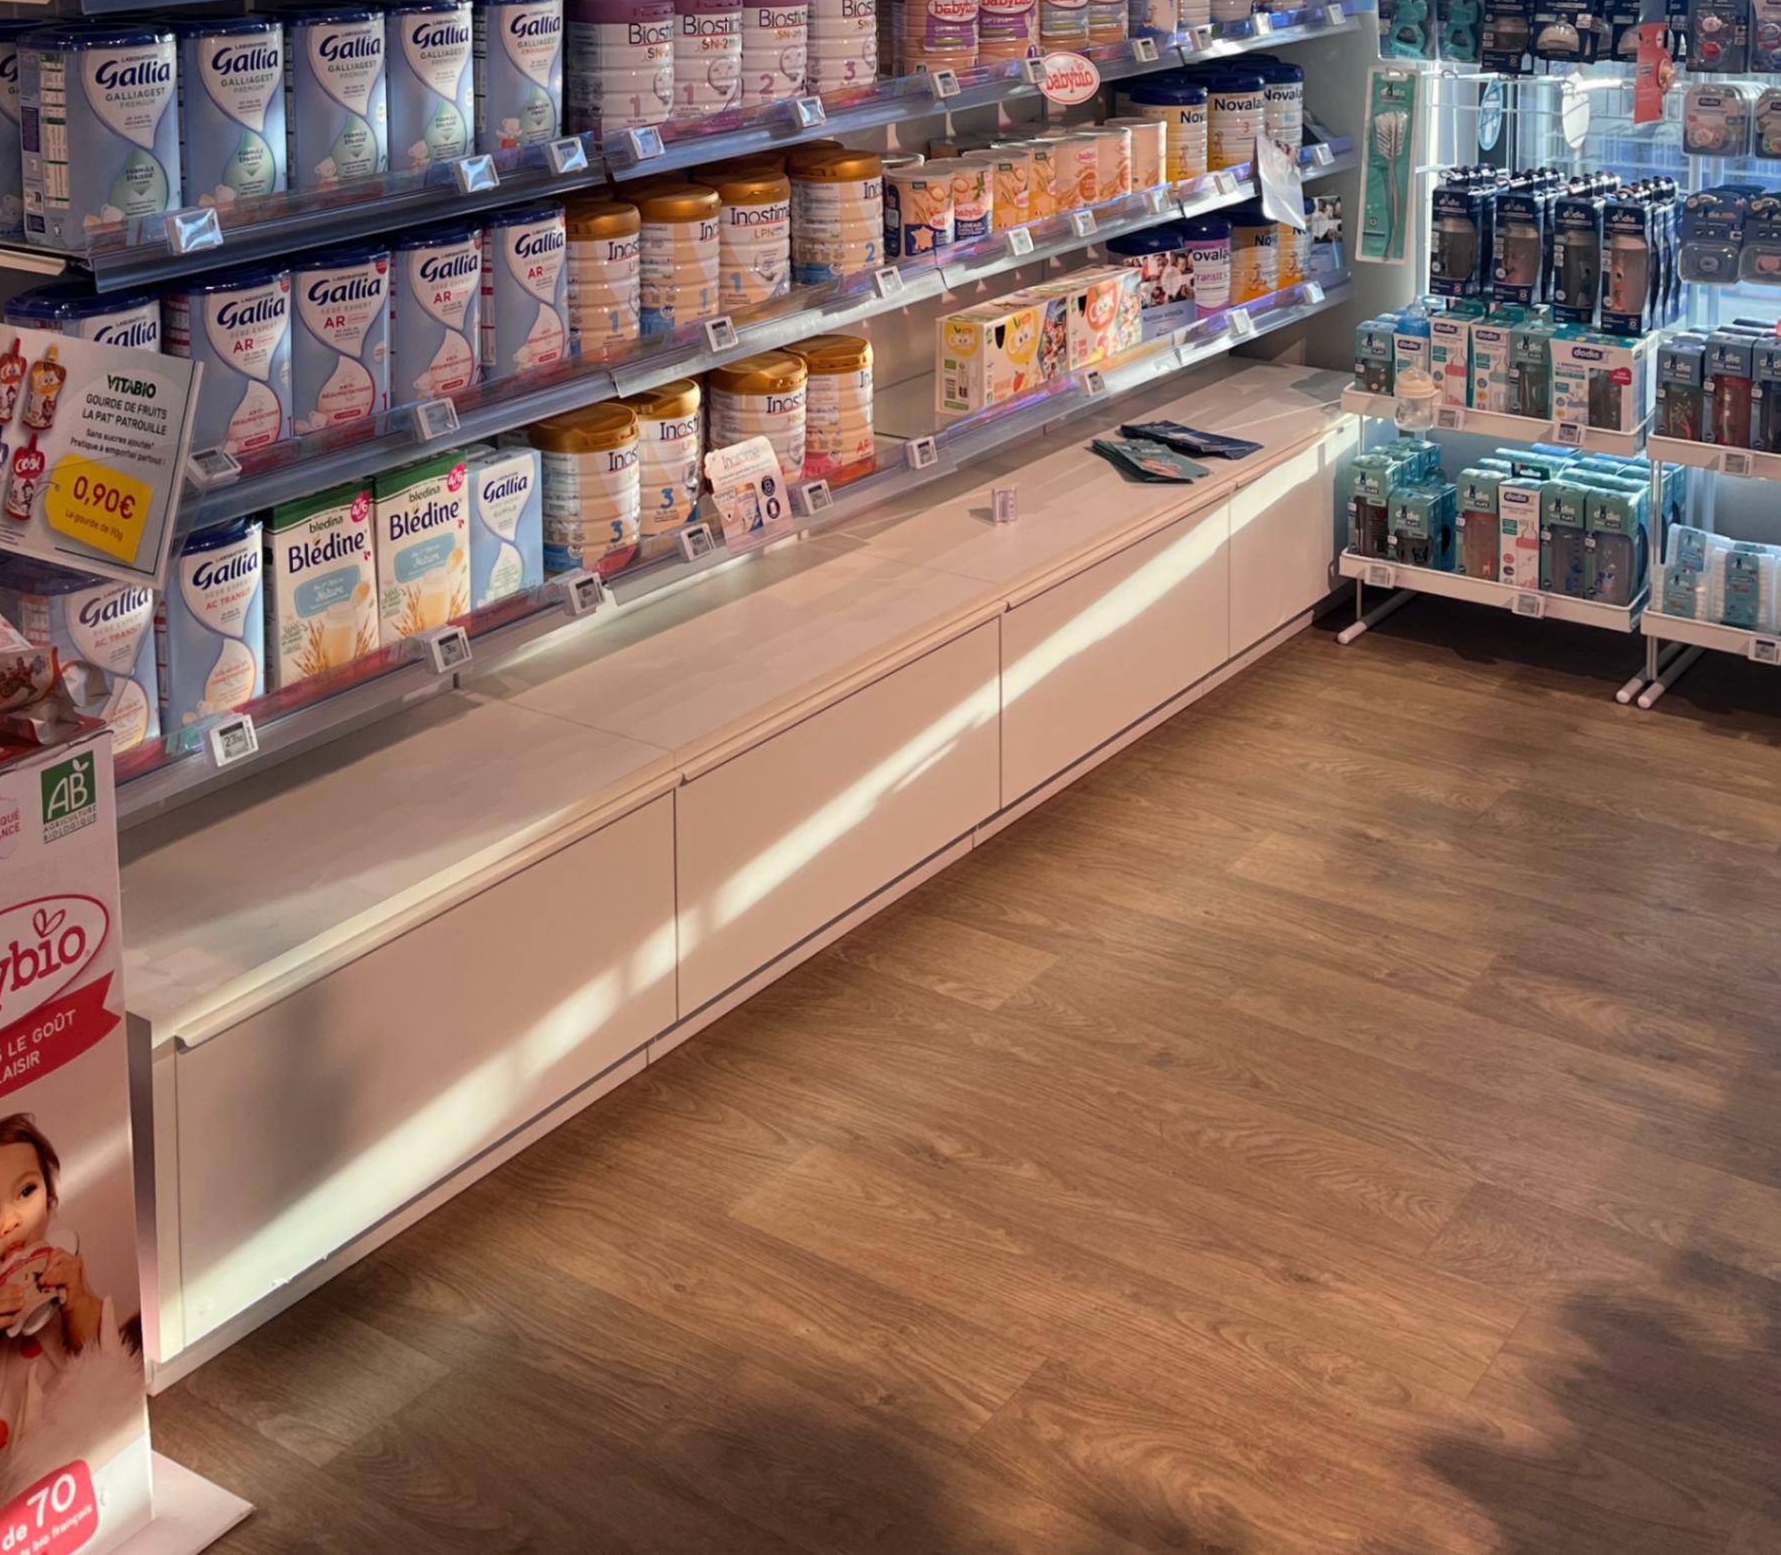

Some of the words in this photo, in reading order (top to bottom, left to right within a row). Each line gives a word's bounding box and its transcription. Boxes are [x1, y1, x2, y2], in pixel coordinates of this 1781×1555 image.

[412, 23, 470, 49] Gallia
[511, 13, 561, 38] Gallia
[320, 35, 382, 61] Gallia
[420, 47, 465, 60] GALLIAGEST
[517, 37, 559, 49] GALLIAGEST
[211, 47, 278, 75] Gallia
[328, 59, 378, 74] GALLIAGEST
[844, 61, 856, 81] 3
[96, 60, 171, 89] Gallia
[220, 73, 274, 88] GALLIAGEST
[760, 75, 774, 95] 2
[1046, 68, 1093, 93] babybio
[106, 87, 166, 102] GALLIAGEST
[683, 84, 694, 106] 1
[629, 97, 641, 118] 1
[1243, 123, 1250, 133] 3
[515, 231, 564, 258] Gallia
[865, 243, 876, 261] 2
[420, 254, 478, 282] Gallia
[527, 266, 544, 279] AR
[308, 277, 381, 305] Gallia
[730, 272, 741, 293] 1
[433, 291, 451, 304] AR
[700, 288, 708, 309] 1
[217, 296, 286, 329] Gallia
[324, 315, 345, 328] AR
[608, 311, 619, 332] 1
[233, 338, 254, 353] AR
[86, 393, 123, 410] GOURDE
[124, 401, 136, 413] DE
[137, 404, 168, 420] FRUITS
[382, 393, 388, 411] 1
[82, 408, 94, 420] LA
[115, 415, 168, 436] PATROUILLE
[287, 416, 292, 436] 1
[70, 436, 98, 451] Pratique
[86, 428, 103, 440] Sans
[104, 434, 127, 444] sucres
[73, 476, 136, 520] 0,90€
[408, 485, 441, 503] blédina
[483, 476, 528, 503] Gallia
[660, 488, 674, 509] 3
[65, 510, 73, 519] La
[74, 513, 99, 530] gourde
[101, 522, 110, 532] de
[110, 527, 124, 542] 90g
[309, 515, 344, 534] blédina
[389, 499, 460, 542] Blédine
[610, 520, 623, 543] 3
[288, 531, 364, 575] Blédine
[192, 550, 258, 590] Gallia
[79, 587, 152, 628] Gallia
[205, 600, 218, 611] AC
[94, 637, 107, 648] AC
[108, 625, 143, 644] TRANSIT
[47, 774, 88, 821] AB
[43, 805, 97, 833] AGRICULTURE
[43, 813, 98, 844] BIOLOGIQUE
[8, 1035, 27, 1056] LE
[32, 1009, 77, 1044] GOÛT
[2, 1521, 27, 1551] de
[26, 1473, 76, 1528] 70
[52, 1505, 93, 1540] français
